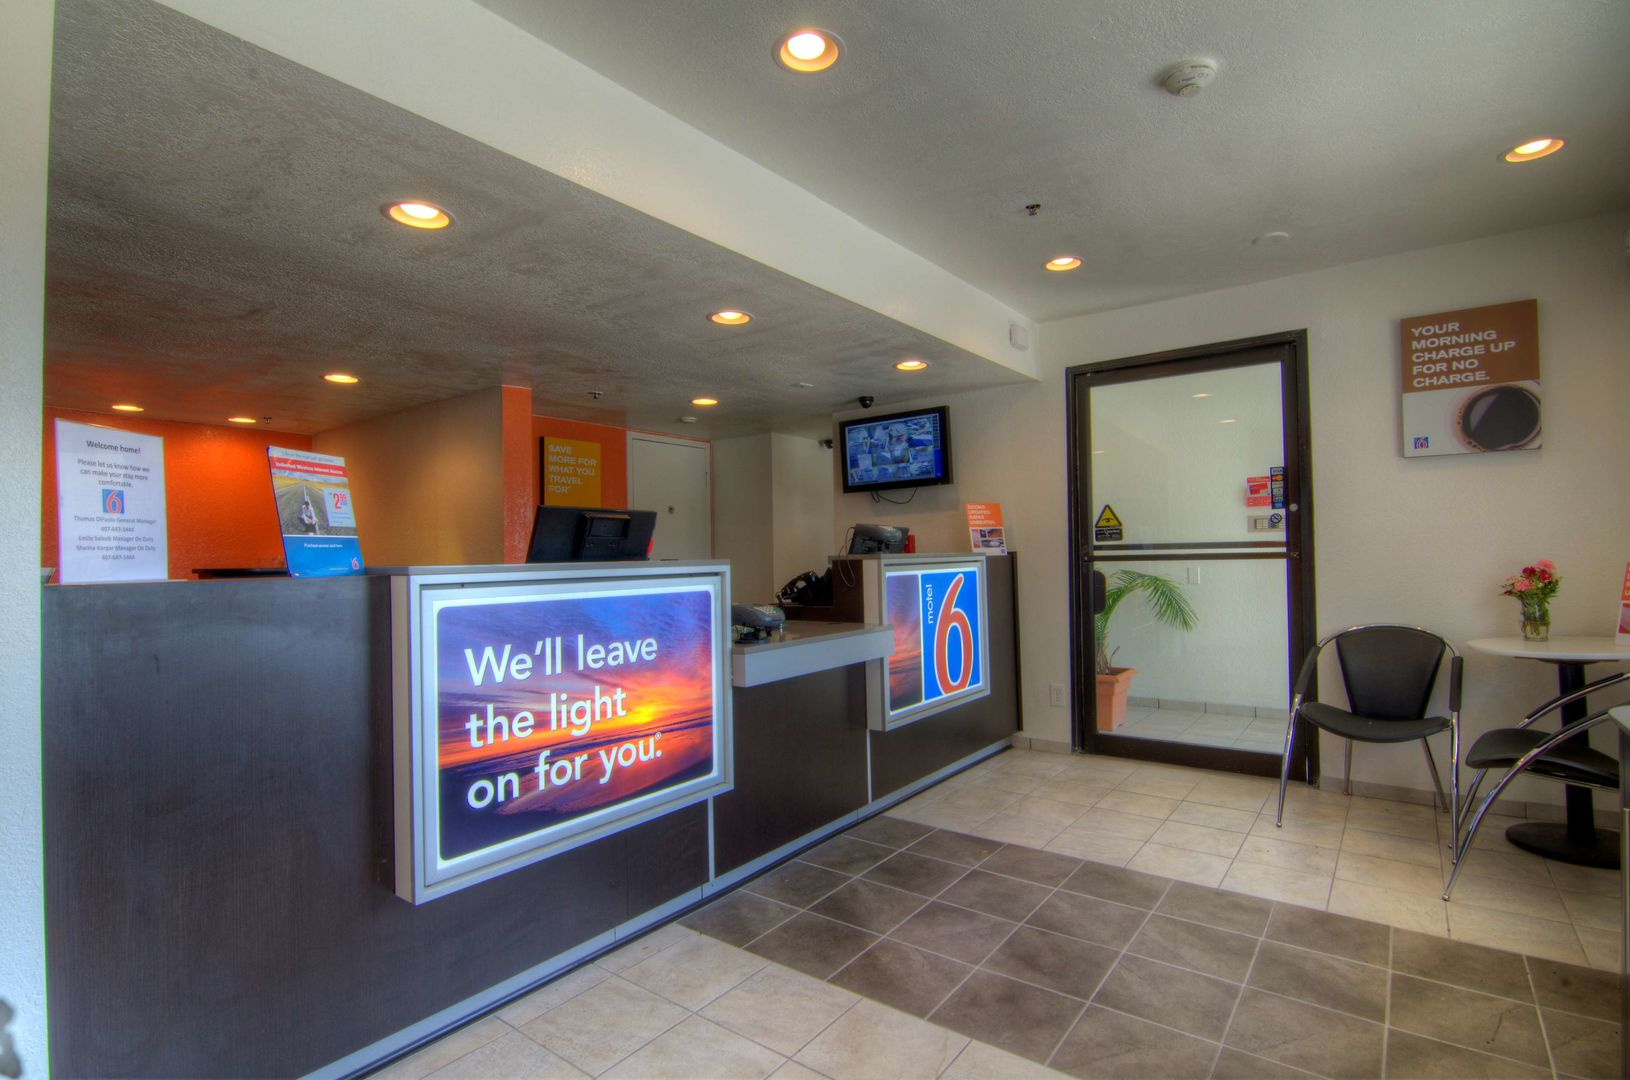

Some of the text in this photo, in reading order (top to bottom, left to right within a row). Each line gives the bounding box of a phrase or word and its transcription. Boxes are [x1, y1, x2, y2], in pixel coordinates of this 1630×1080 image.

[1411, 322, 1460, 337] YOUR
[1412, 330, 1497, 350] MORNING
[1412, 341, 1516, 362] CHARGE UP
[1413, 359, 1479, 375] FOR NO
[1413, 371, 1490, 388] CHARGE.
[86, 440, 141, 454] Welcome home!
[549, 444, 572, 454] SAVE
[78, 458, 96, 467] Please
[549, 456, 597, 466] MORE FOR
[92, 469, 108, 478] make
[109, 472, 122, 480] your
[123, 472, 134, 480] stay
[549, 464, 596, 476] WHAT YOU
[98, 480, 134, 488] comfortable.
[549, 474, 583, 485] TRAVEL
[106, 490, 122, 514] 6
[926, 573, 974, 696] motel 6
[463, 634, 658, 686] We'll leave
[465, 685, 627, 748] the light
[467, 771, 520, 809] on
[534, 750, 588, 791] for
